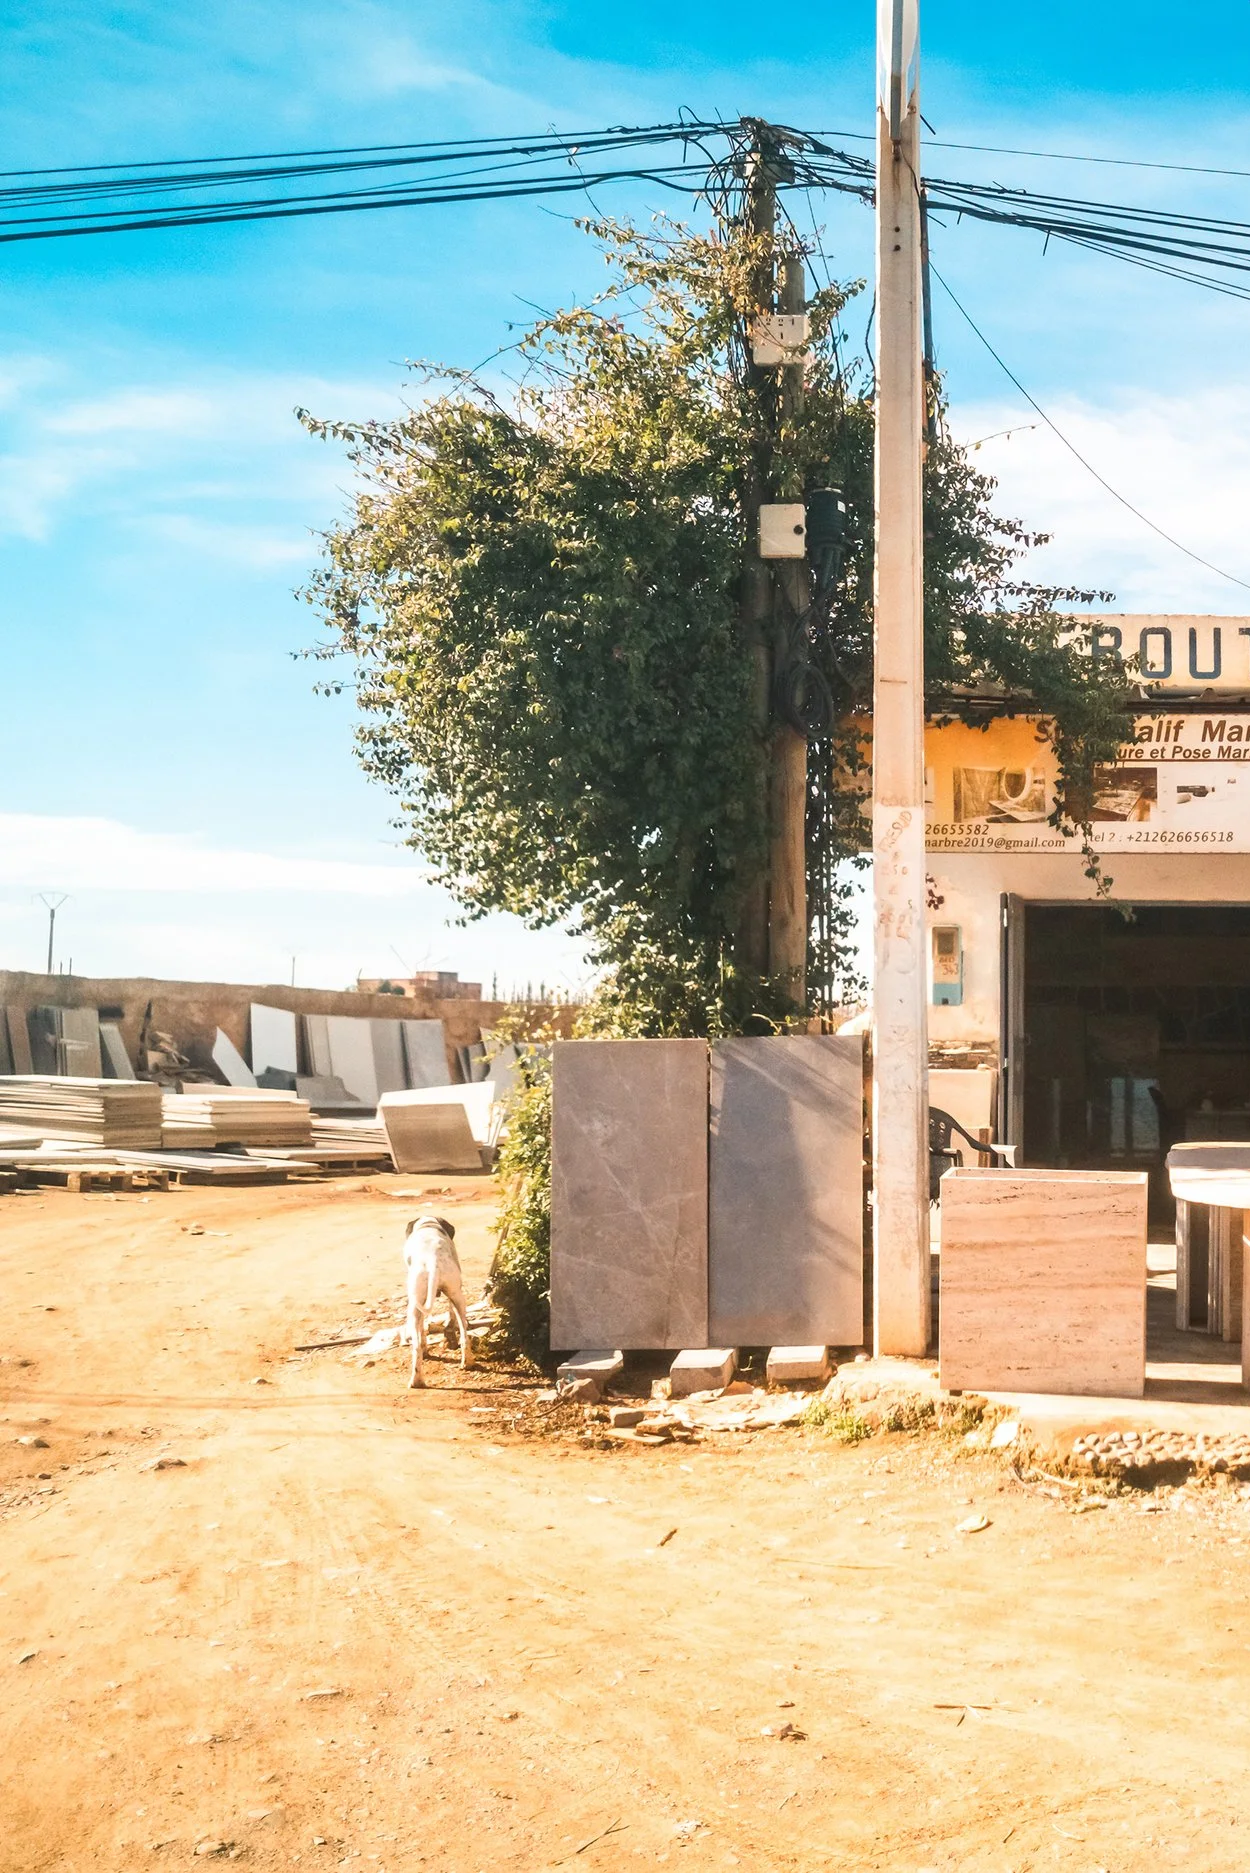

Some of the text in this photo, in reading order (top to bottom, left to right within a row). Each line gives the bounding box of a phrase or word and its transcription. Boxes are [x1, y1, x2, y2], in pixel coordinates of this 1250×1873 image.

[1136, 719, 1185, 743] alif
[1149, 746, 1166, 759] et
[1171, 745, 1212, 759] Pose
[925, 823, 990, 835] 26655582
[1126, 831, 1234, 843] +212626656518
